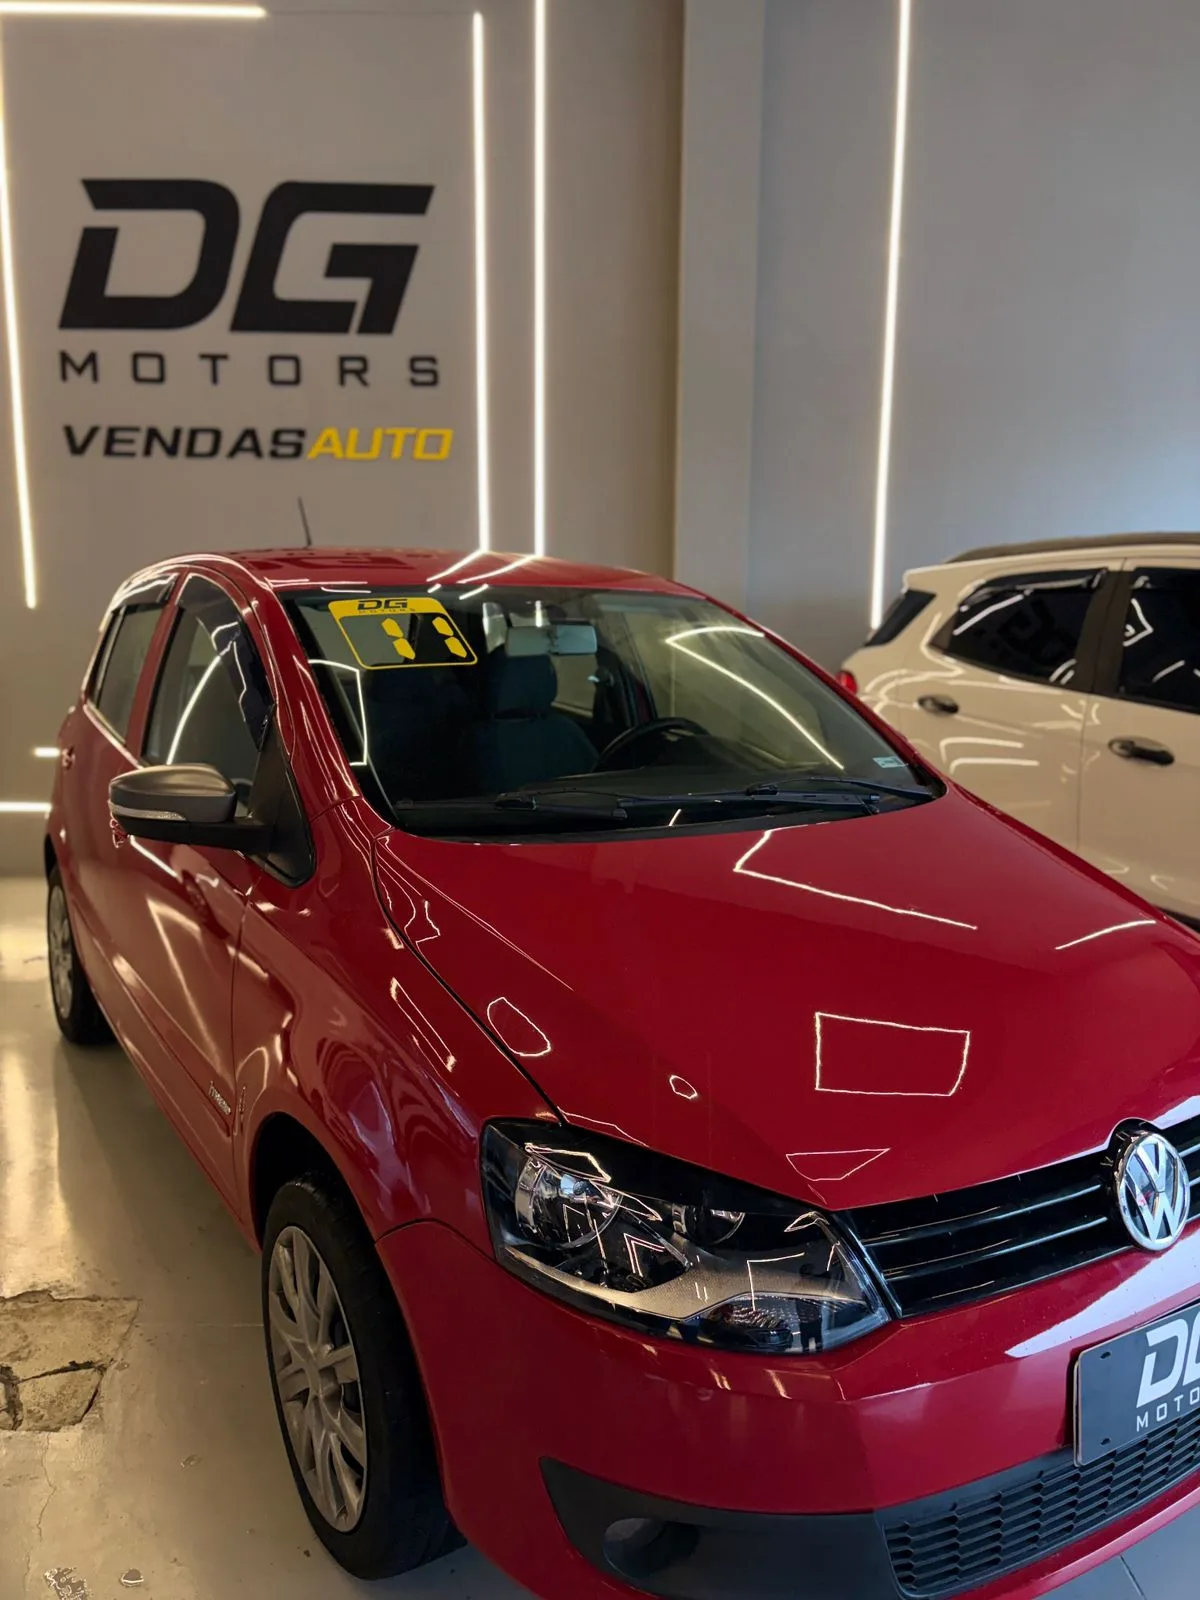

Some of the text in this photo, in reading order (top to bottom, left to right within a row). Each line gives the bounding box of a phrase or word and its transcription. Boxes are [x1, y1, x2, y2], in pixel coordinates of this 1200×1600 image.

[58, 178, 436, 335] DG
[58, 350, 441, 388] MOTORS
[357, 598, 408, 610] DG
[1136, 1386, 1200, 1433] MOTO
